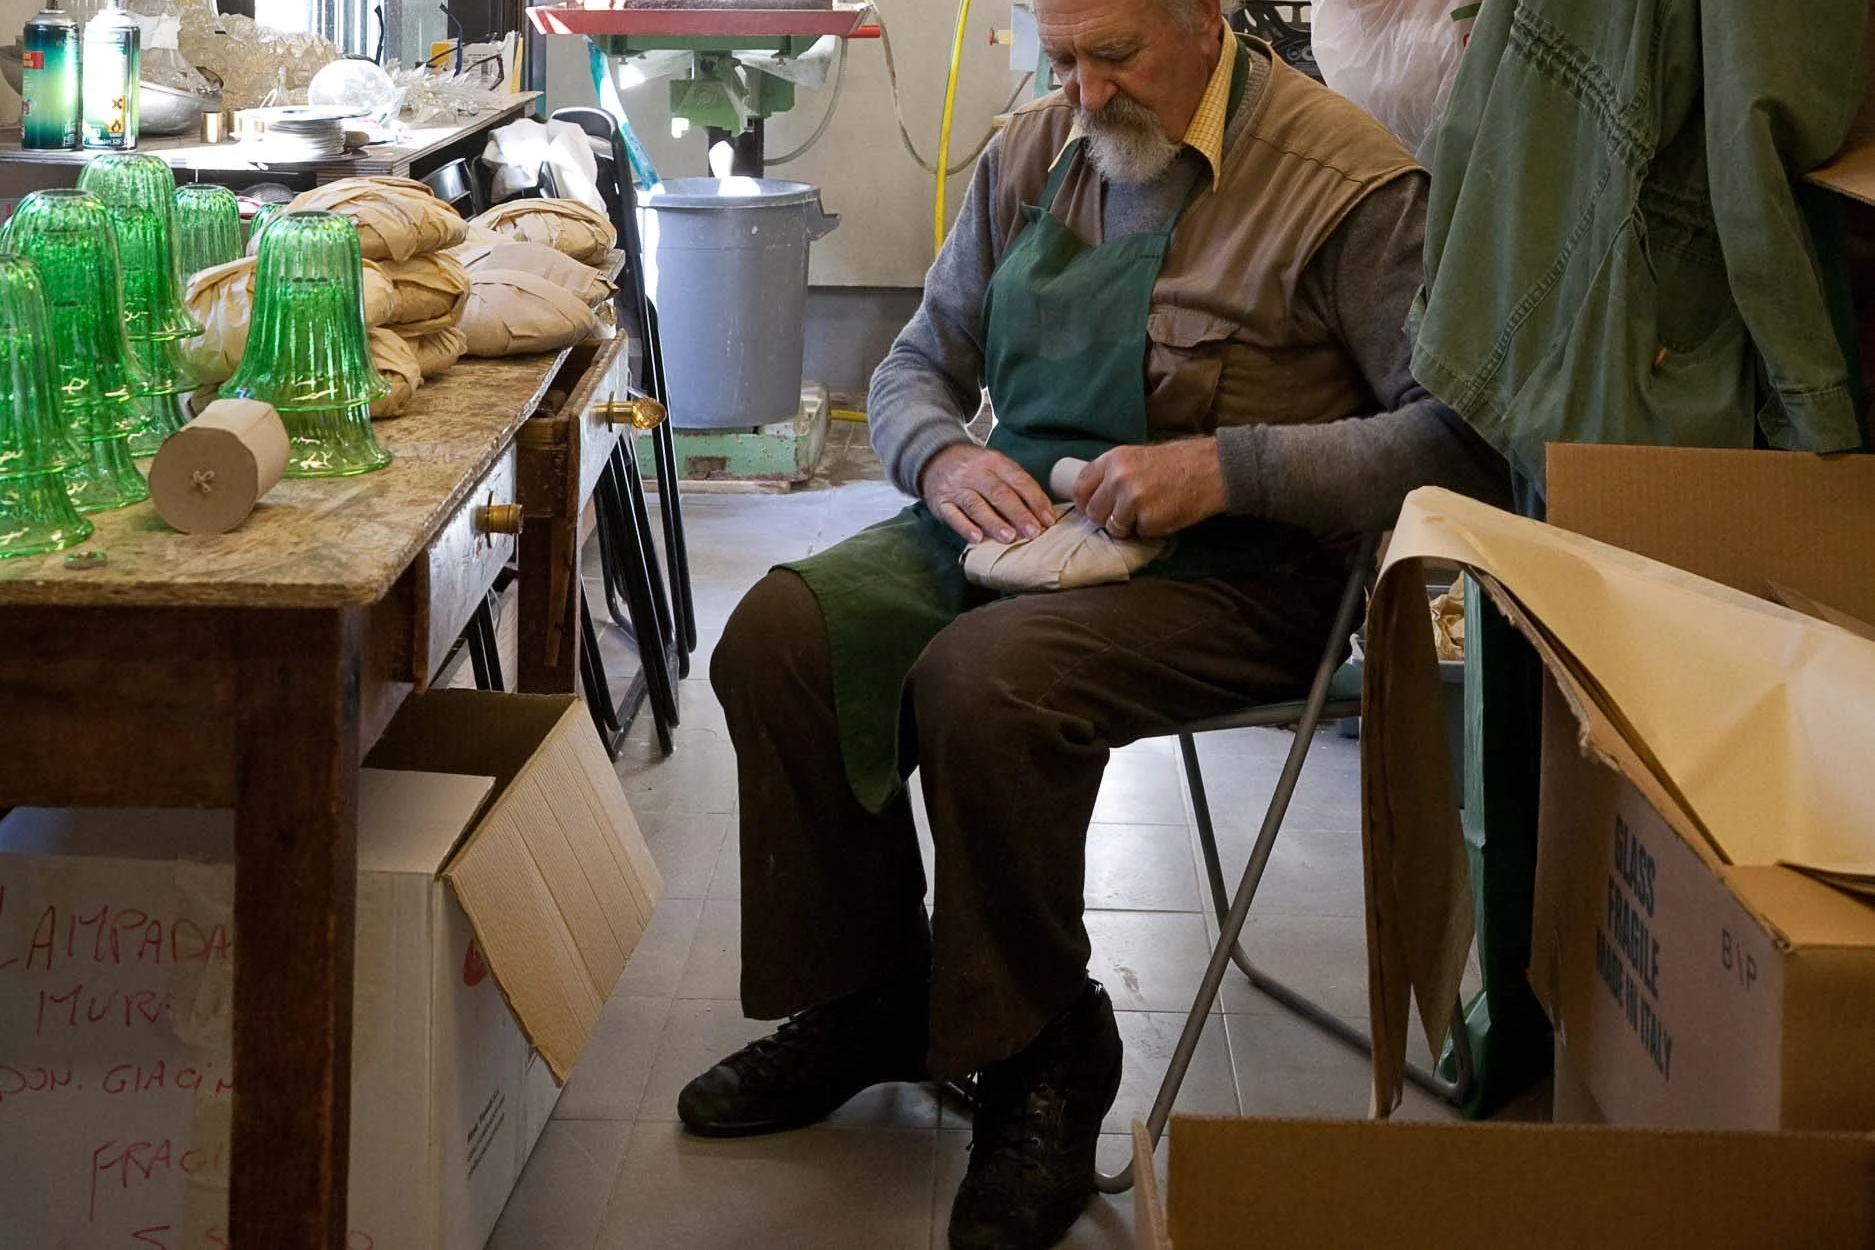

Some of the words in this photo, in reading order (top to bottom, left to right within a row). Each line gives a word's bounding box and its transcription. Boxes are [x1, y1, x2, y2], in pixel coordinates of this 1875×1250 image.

[1614, 814, 1656, 918] GLASS
[1608, 875, 1660, 1000] FRAGILE
[1641, 996, 1672, 1084] ITALY
